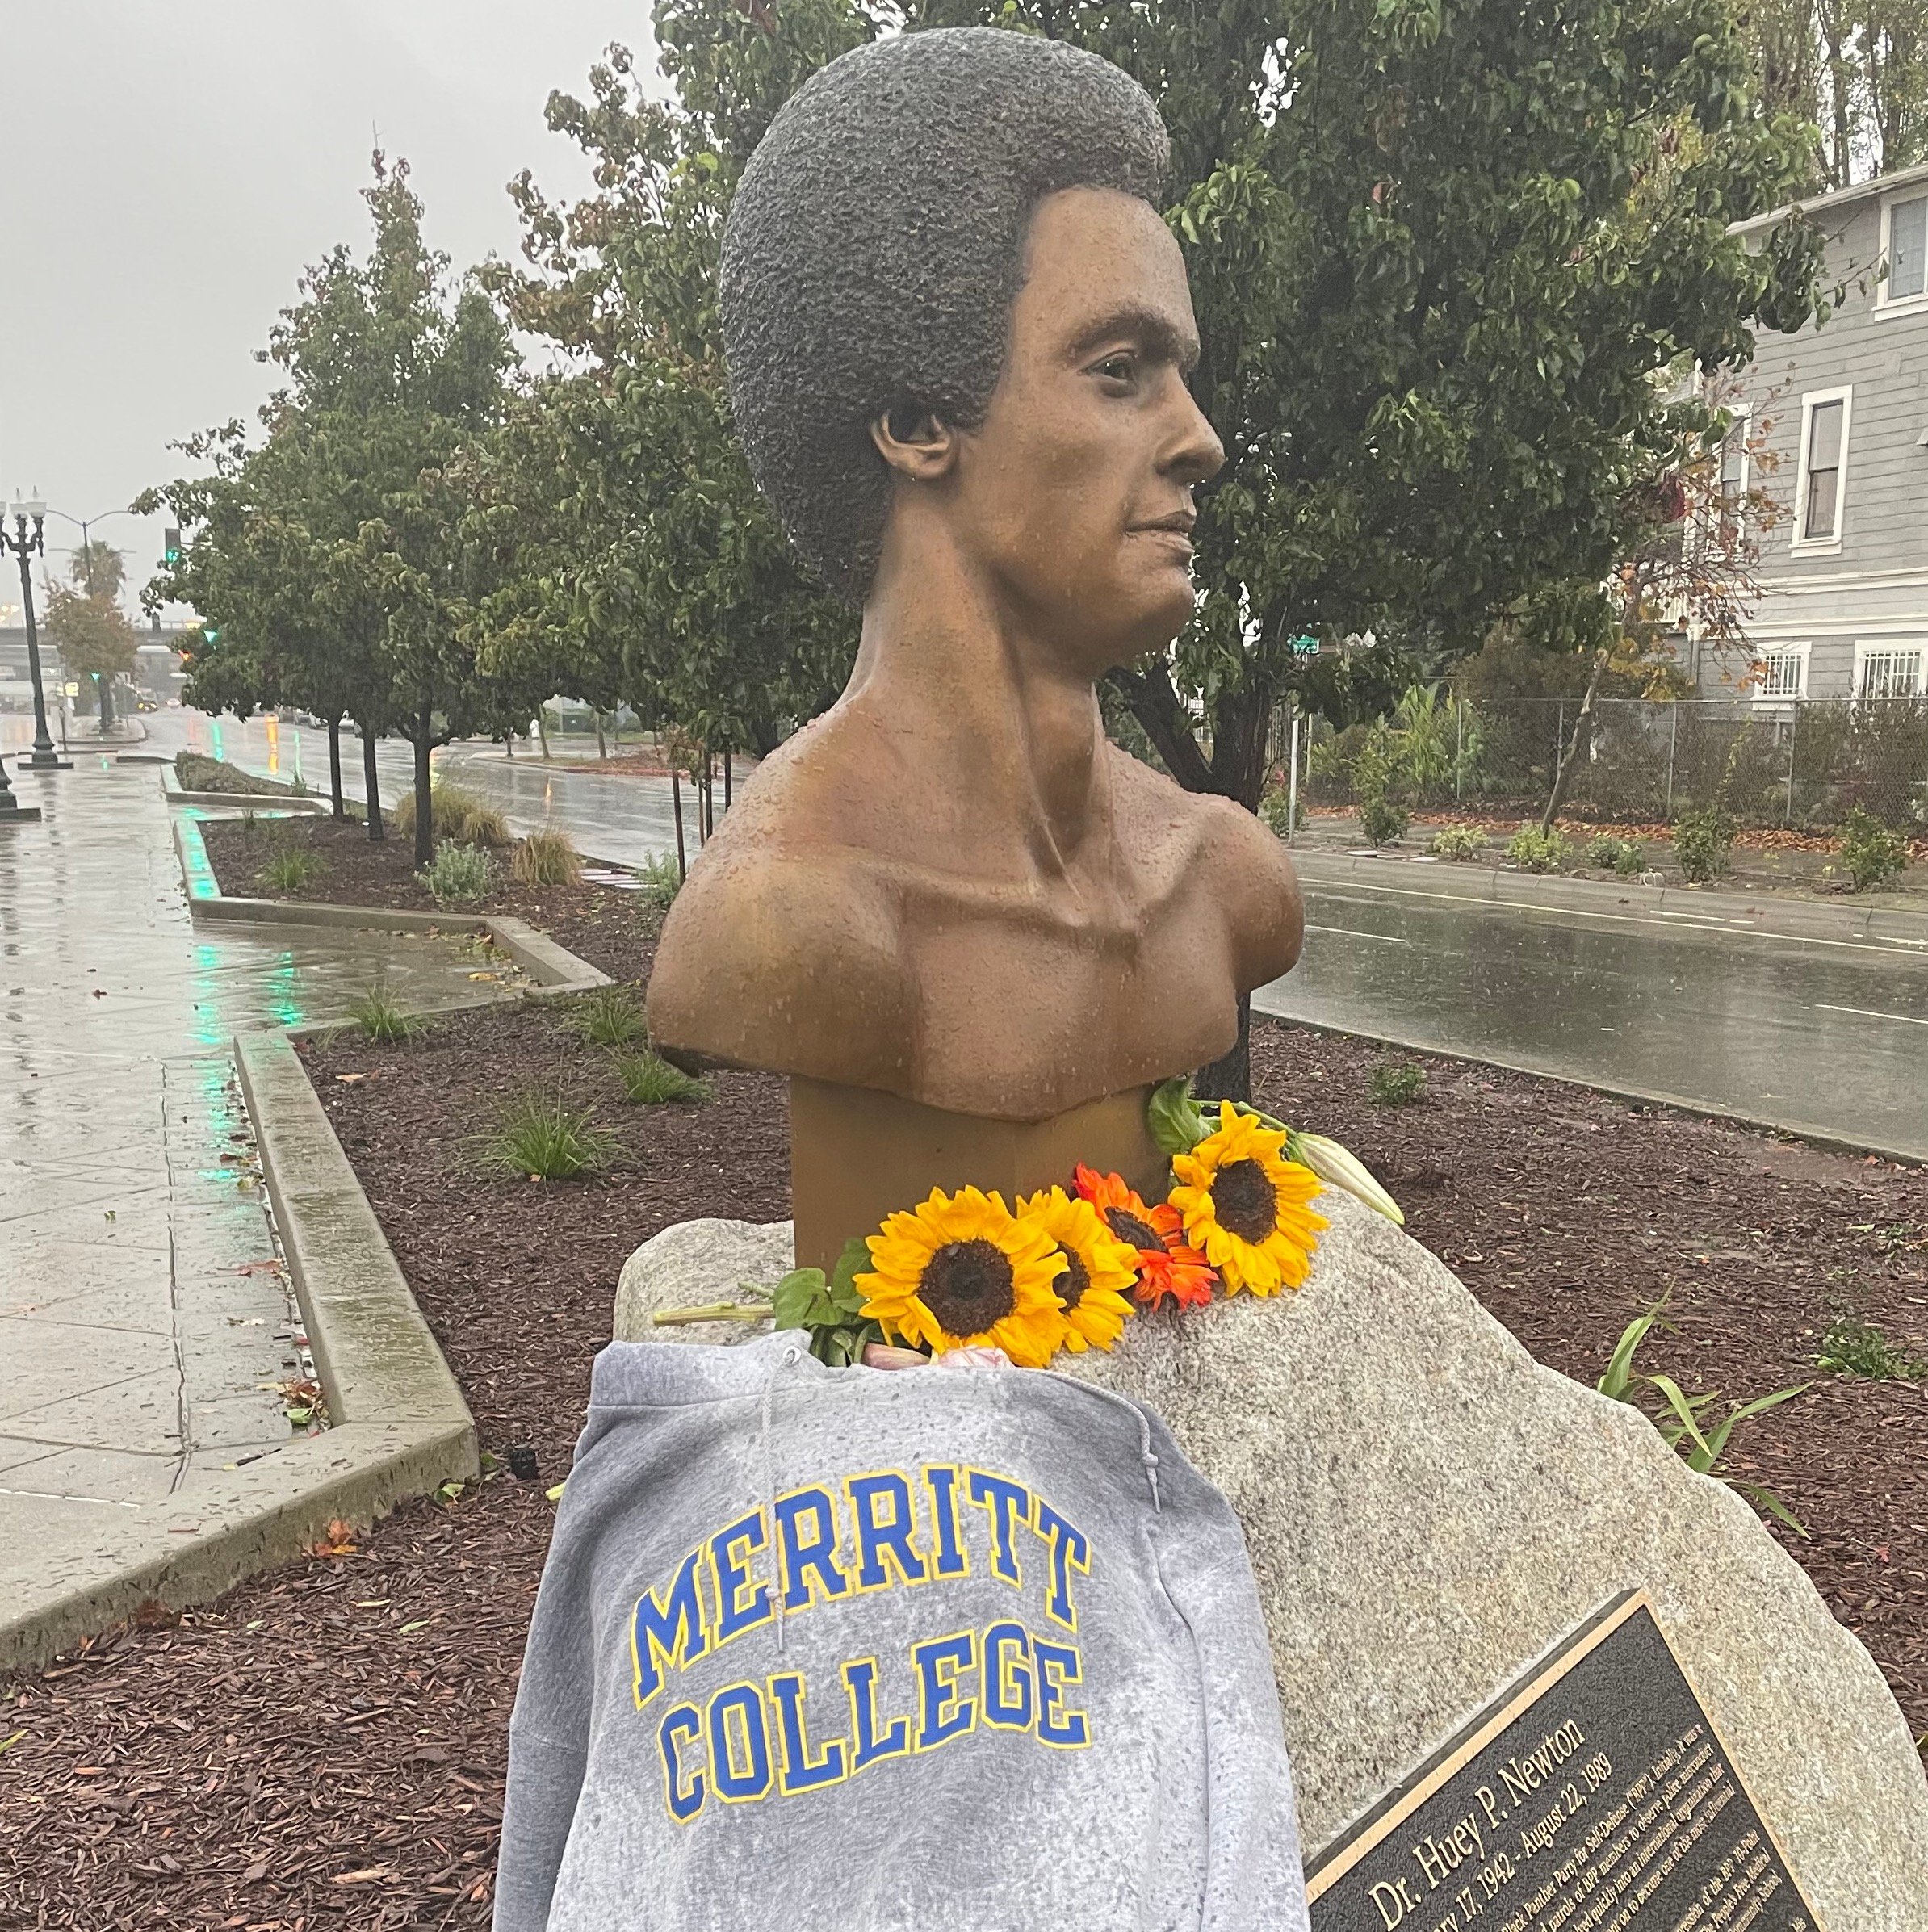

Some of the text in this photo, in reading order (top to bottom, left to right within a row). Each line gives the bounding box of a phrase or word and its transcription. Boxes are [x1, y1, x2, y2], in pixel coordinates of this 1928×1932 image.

[630, 1463, 1091, 1710] MERRITT
[657, 1619, 1091, 1825] COLLEGE
[1368, 1719, 1585, 1932] Dr. Huey P. Newton
[1456, 1887, 1484, 1922] 17,
[1477, 1852, 1515, 1900] 1942
[1521, 1804, 1567, 1859] August
[1561, 1783, 1588, 1815] 22,
[1580, 1752, 1612, 1793] 1989
[1549, 1897, 1576, 1932] patrols
[1574, 1882, 1586, 1903] of
[1581, 1867, 1599, 1893] BPP
[1599, 1836, 1631, 1875] members
[1629, 1827, 1640, 1841] to
[1638, 1800, 1664, 1831] observe
[1662, 1779, 1682, 1809] police
[1591, 1887, 1619, 1924] quickly
[1613, 1871, 1632, 1894] into
[1629, 1861, 1641, 1877] an
[1636, 1813, 1679, 1867] international
[1676, 1778, 1713, 1821] organization
[1709, 1763, 1725, 1783] that
[1672, 1842, 1683, 1861] of
[1679, 1835, 1693, 1853] the
[1690, 1817, 1708, 1840] most
[1523, 1881, 1557, 1920] Panther
[1553, 1859, 1578, 1887] Party
[1574, 1846, 1589, 1866] for
[1586, 1803, 1630, 1853] Self-Defense
[1633, 1871, 1663, 1905] become
[1661, 1857, 1675, 1875] one
[1703, 1886, 1712, 1906] of
[1709, 1877, 1724, 1896] the
[1720, 1858, 1735, 1881] BPP
[1733, 1829, 1760, 1864] 10-Point
[1733, 1878, 1750, 1900] Free
[1746, 1846, 1771, 1884] Medical
[1619, 1909, 1632, 1926] on
[1628, 1900, 1639, 1914] to
